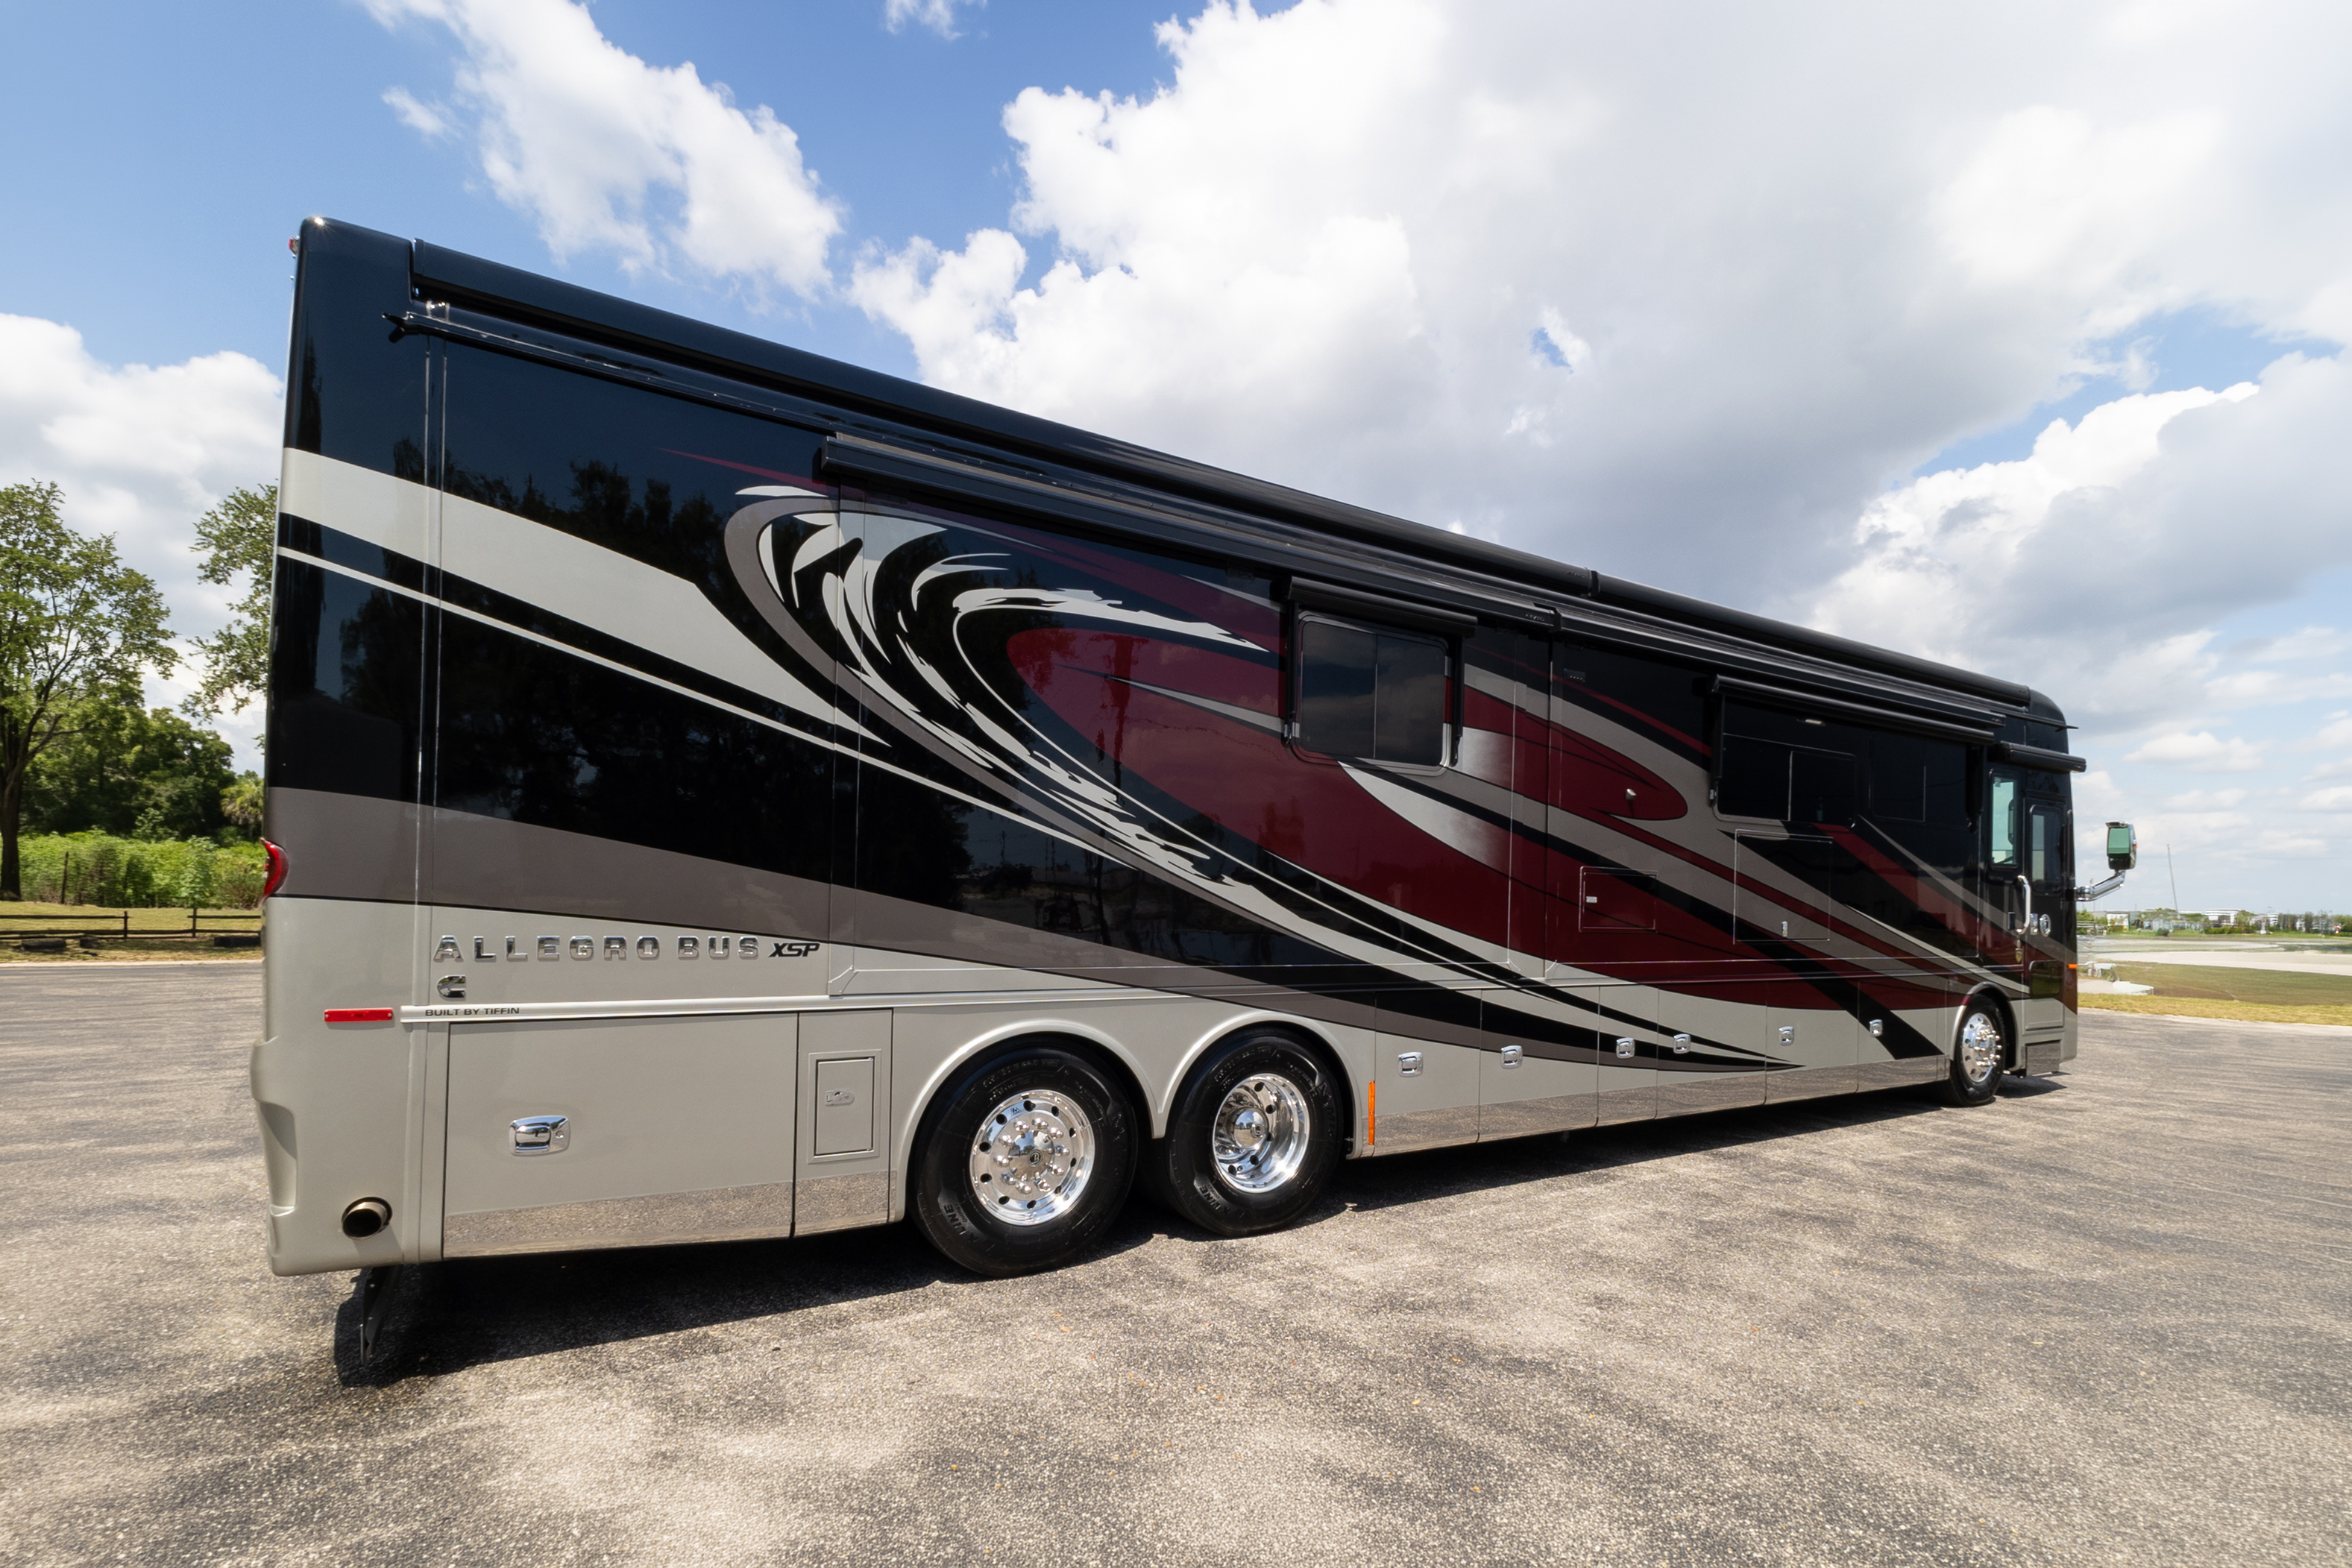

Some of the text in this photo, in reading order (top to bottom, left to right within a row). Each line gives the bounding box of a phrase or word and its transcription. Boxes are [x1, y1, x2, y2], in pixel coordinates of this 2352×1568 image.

[433, 935, 820, 962] ALLEGRO BUS XSP
[425, 1007, 520, 1018] BUILT BY TIFFIN
[1199, 1186, 1221, 1210] LINE
[943, 1203, 967, 1235] LINE
